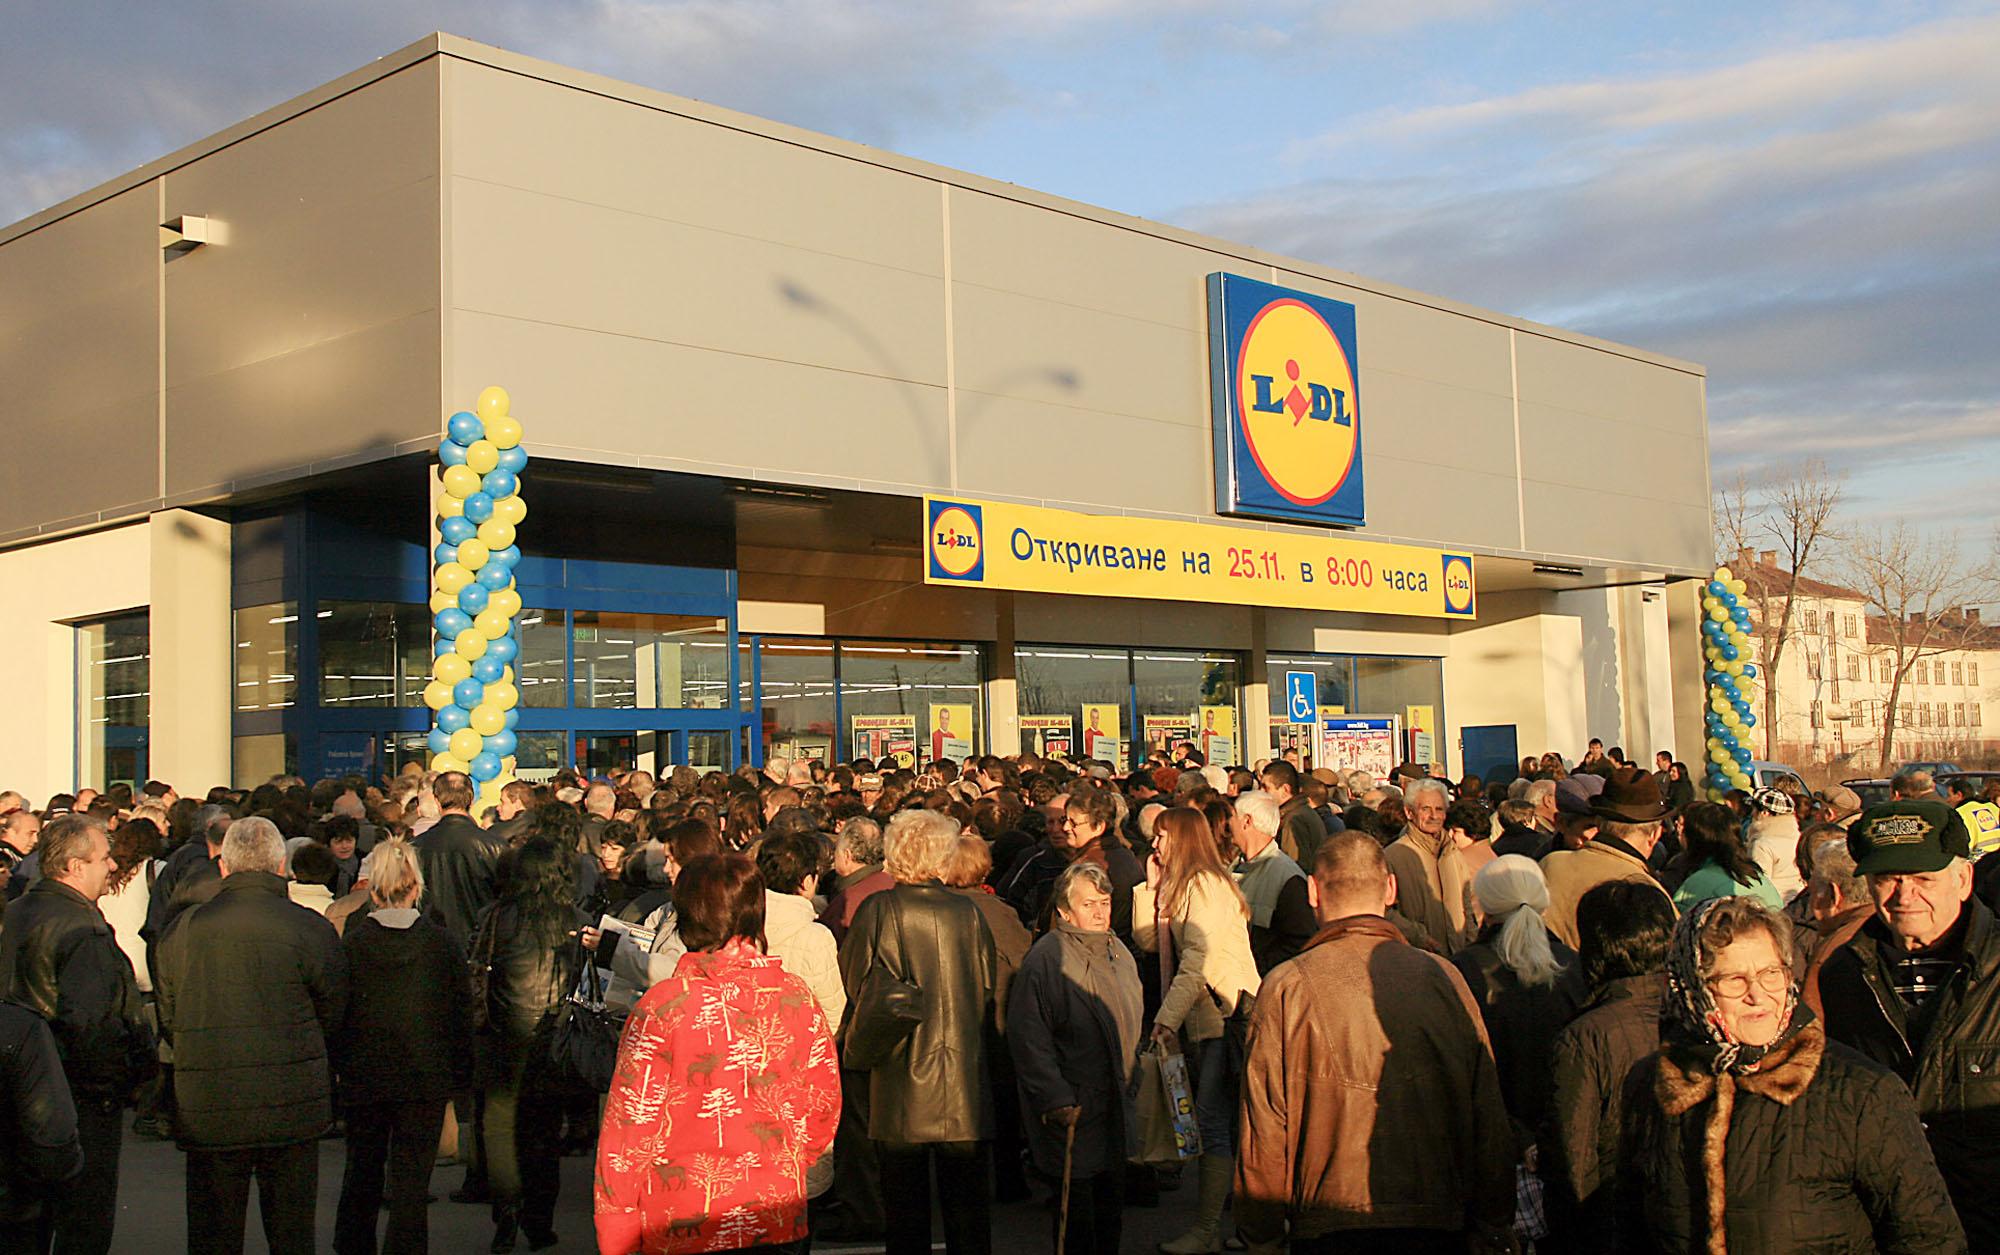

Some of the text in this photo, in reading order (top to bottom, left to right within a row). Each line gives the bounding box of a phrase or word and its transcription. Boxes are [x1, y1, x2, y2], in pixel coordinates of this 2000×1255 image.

[1250, 359, 1352, 428] LIDL
[937, 528, 976, 549] LIDL
[1010, 527, 1428, 592] Откриване на 25.11. в 8:00 часа
